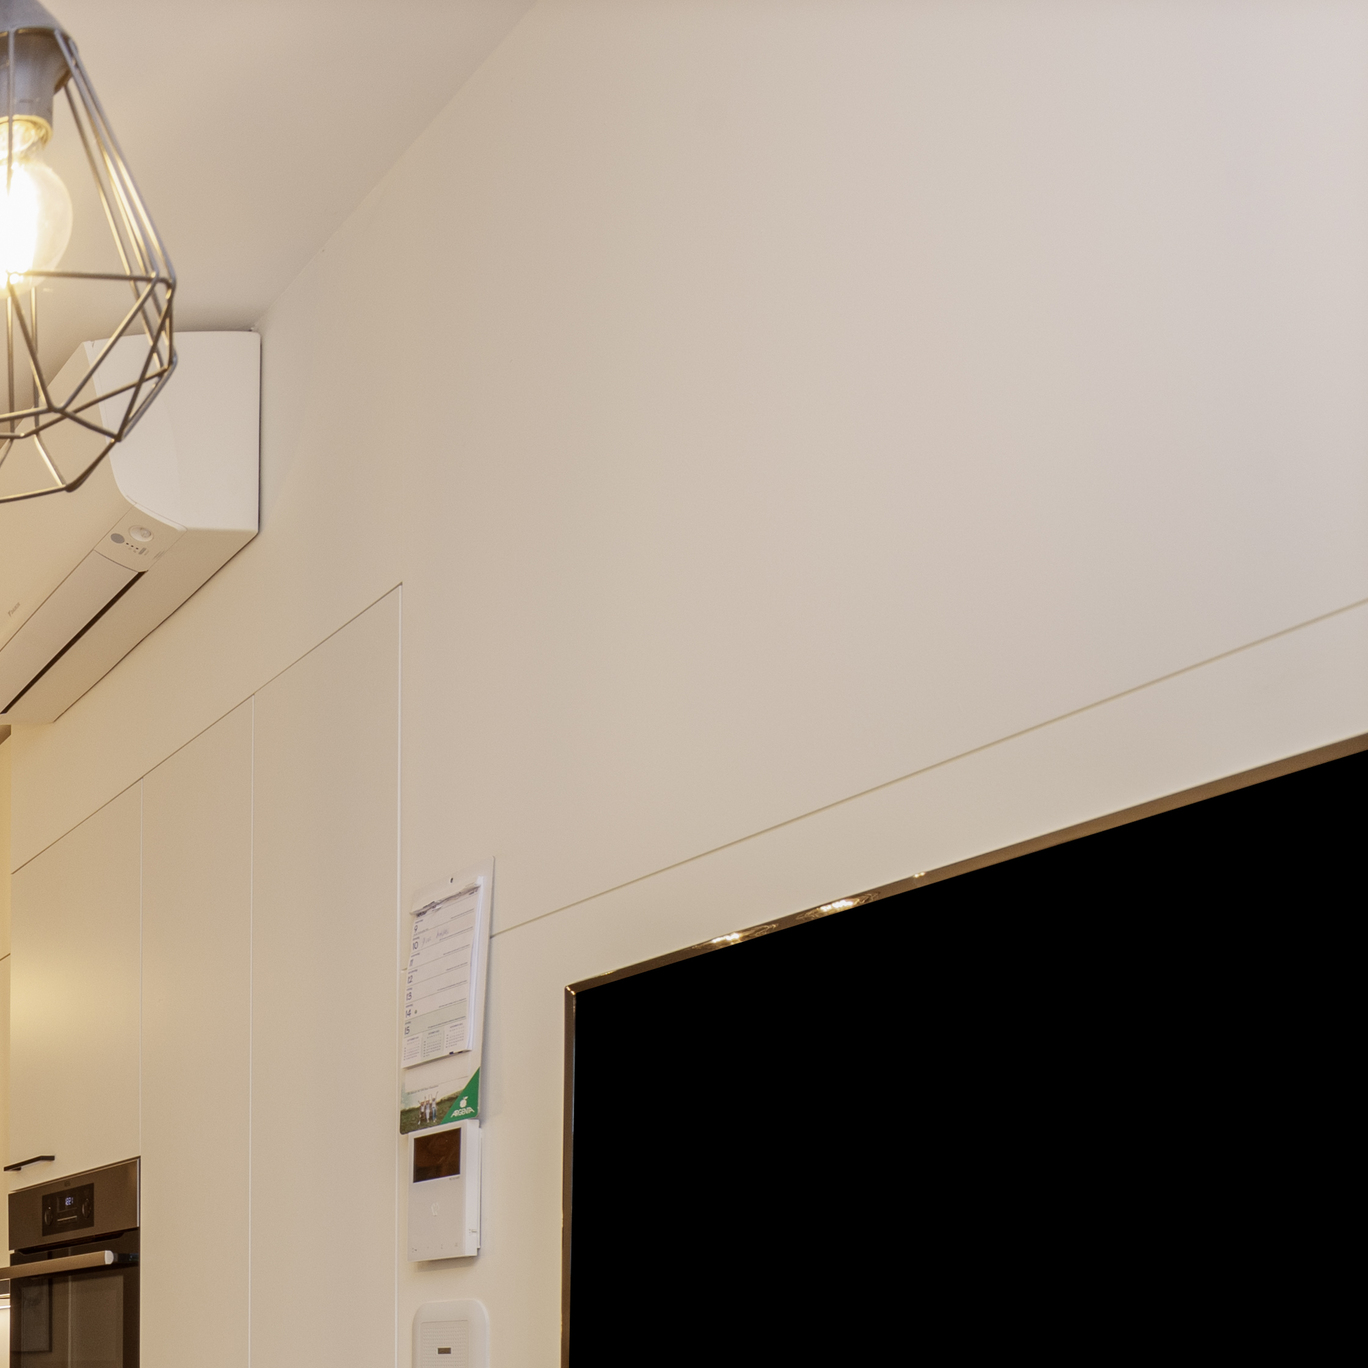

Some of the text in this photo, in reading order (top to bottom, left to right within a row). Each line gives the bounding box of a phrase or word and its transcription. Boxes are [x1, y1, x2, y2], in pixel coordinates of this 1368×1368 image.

[414, 924, 419, 933] 9
[412, 941, 419, 951] 10
[407, 974, 413, 985] 12
[405, 1008, 411, 1018] 14
[404, 1025, 410, 1035] 15
[450, 1106, 475, 1118] ARGENTA
